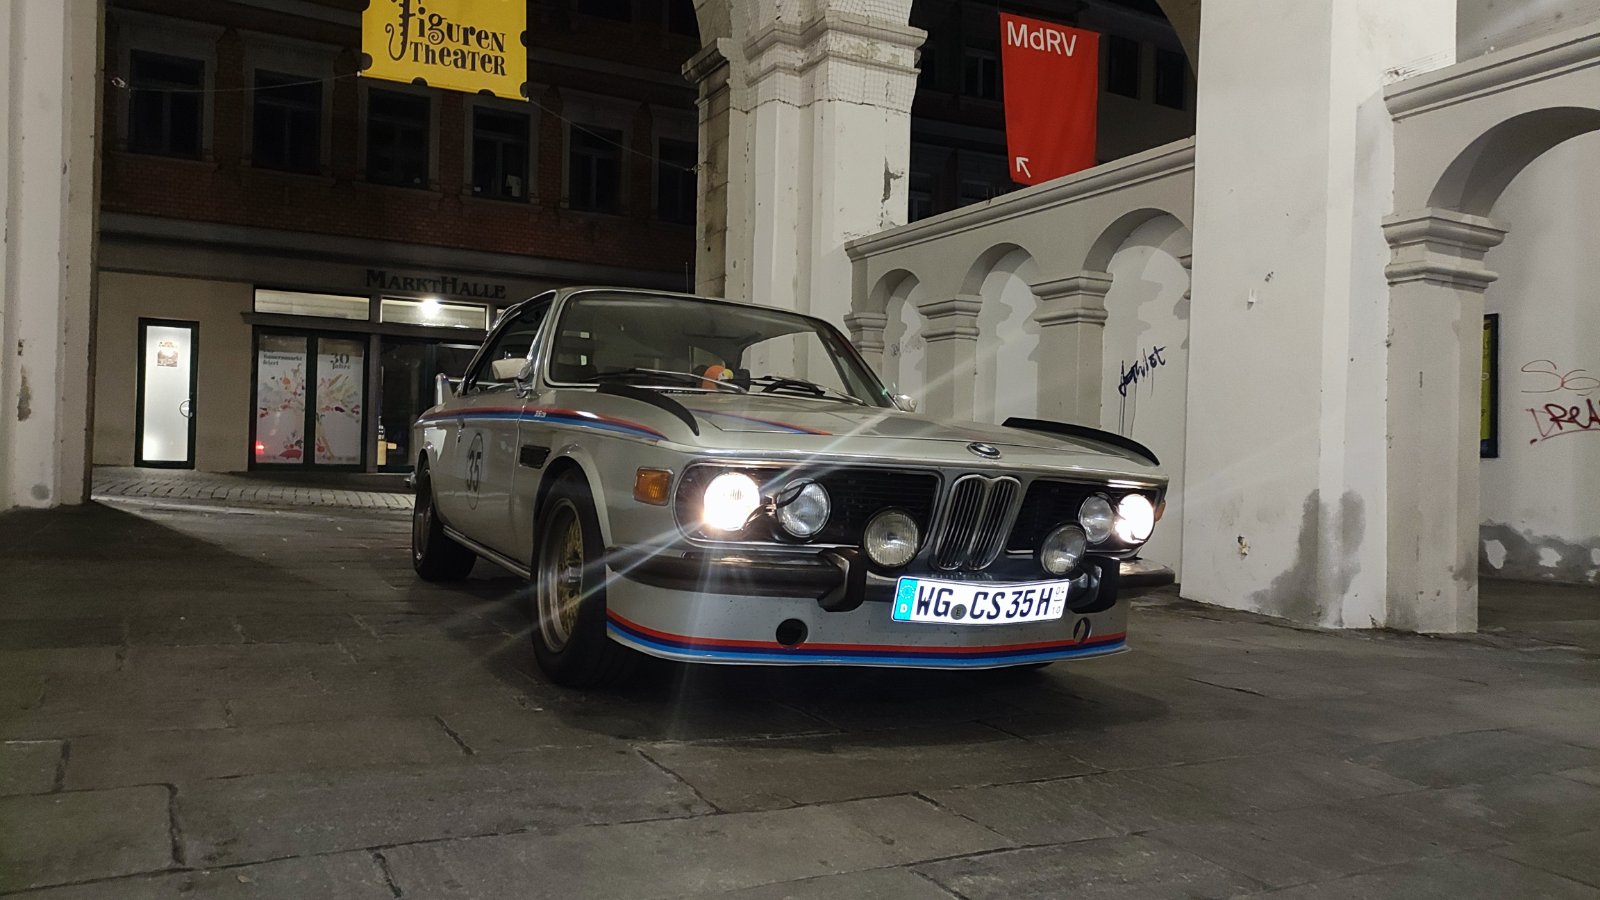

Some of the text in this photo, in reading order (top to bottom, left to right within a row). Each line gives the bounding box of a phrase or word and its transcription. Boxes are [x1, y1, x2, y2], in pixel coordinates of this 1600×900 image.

[1007, 21, 1057, 57] MdRV
[330, 352, 350, 364] 30
[916, 585, 953, 618] WG
